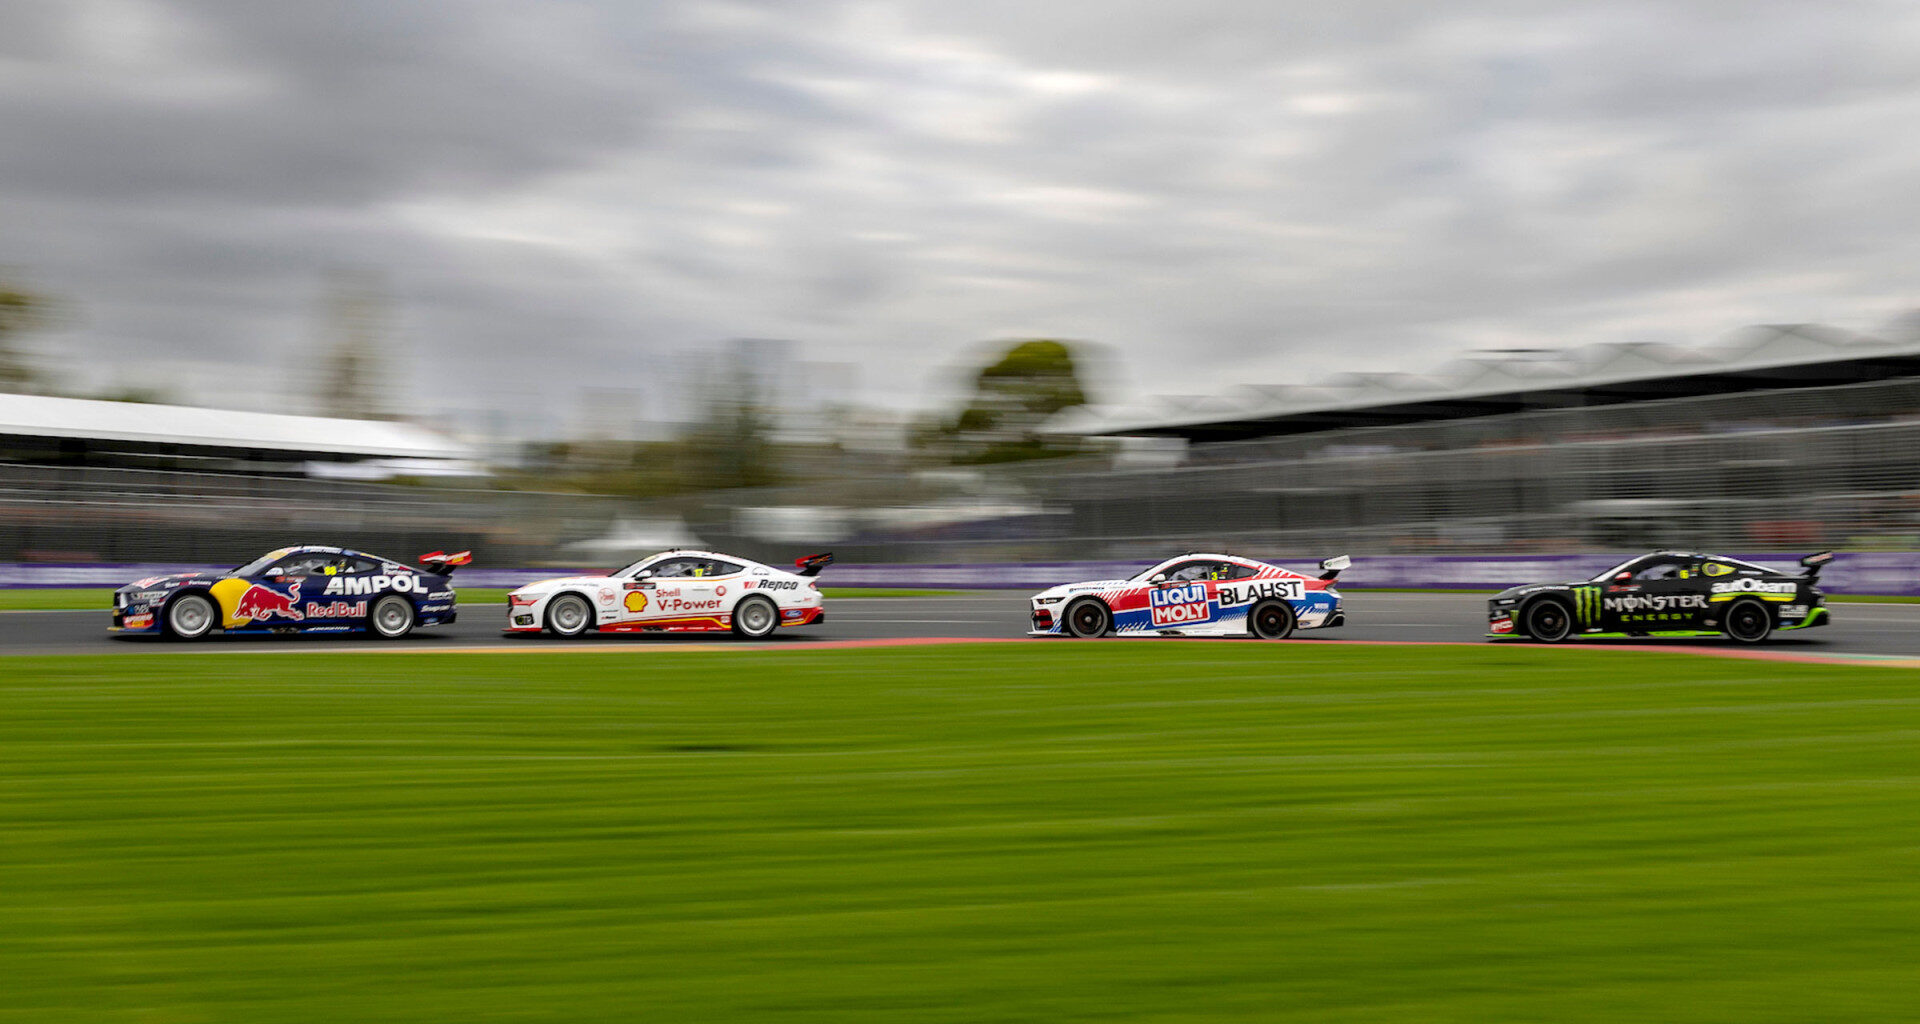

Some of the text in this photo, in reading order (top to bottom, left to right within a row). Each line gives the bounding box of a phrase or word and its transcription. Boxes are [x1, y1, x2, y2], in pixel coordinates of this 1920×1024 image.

[1211, 571, 1218, 581] 3
[323, 575, 428, 596] AMPOL
[656, 588, 681, 598] Shell
[758, 579, 798, 591] Repco
[1219, 581, 1301, 606] BLAHST
[657, 598, 722, 611] V-Power
[1152, 585, 1204, 607] LIQUI
[1604, 594, 1710, 612] MONSTER
[307, 601, 367, 618] Red Bull
[1155, 602, 1208, 623] MOLY
[1620, 613, 1694, 622] ENERGY
